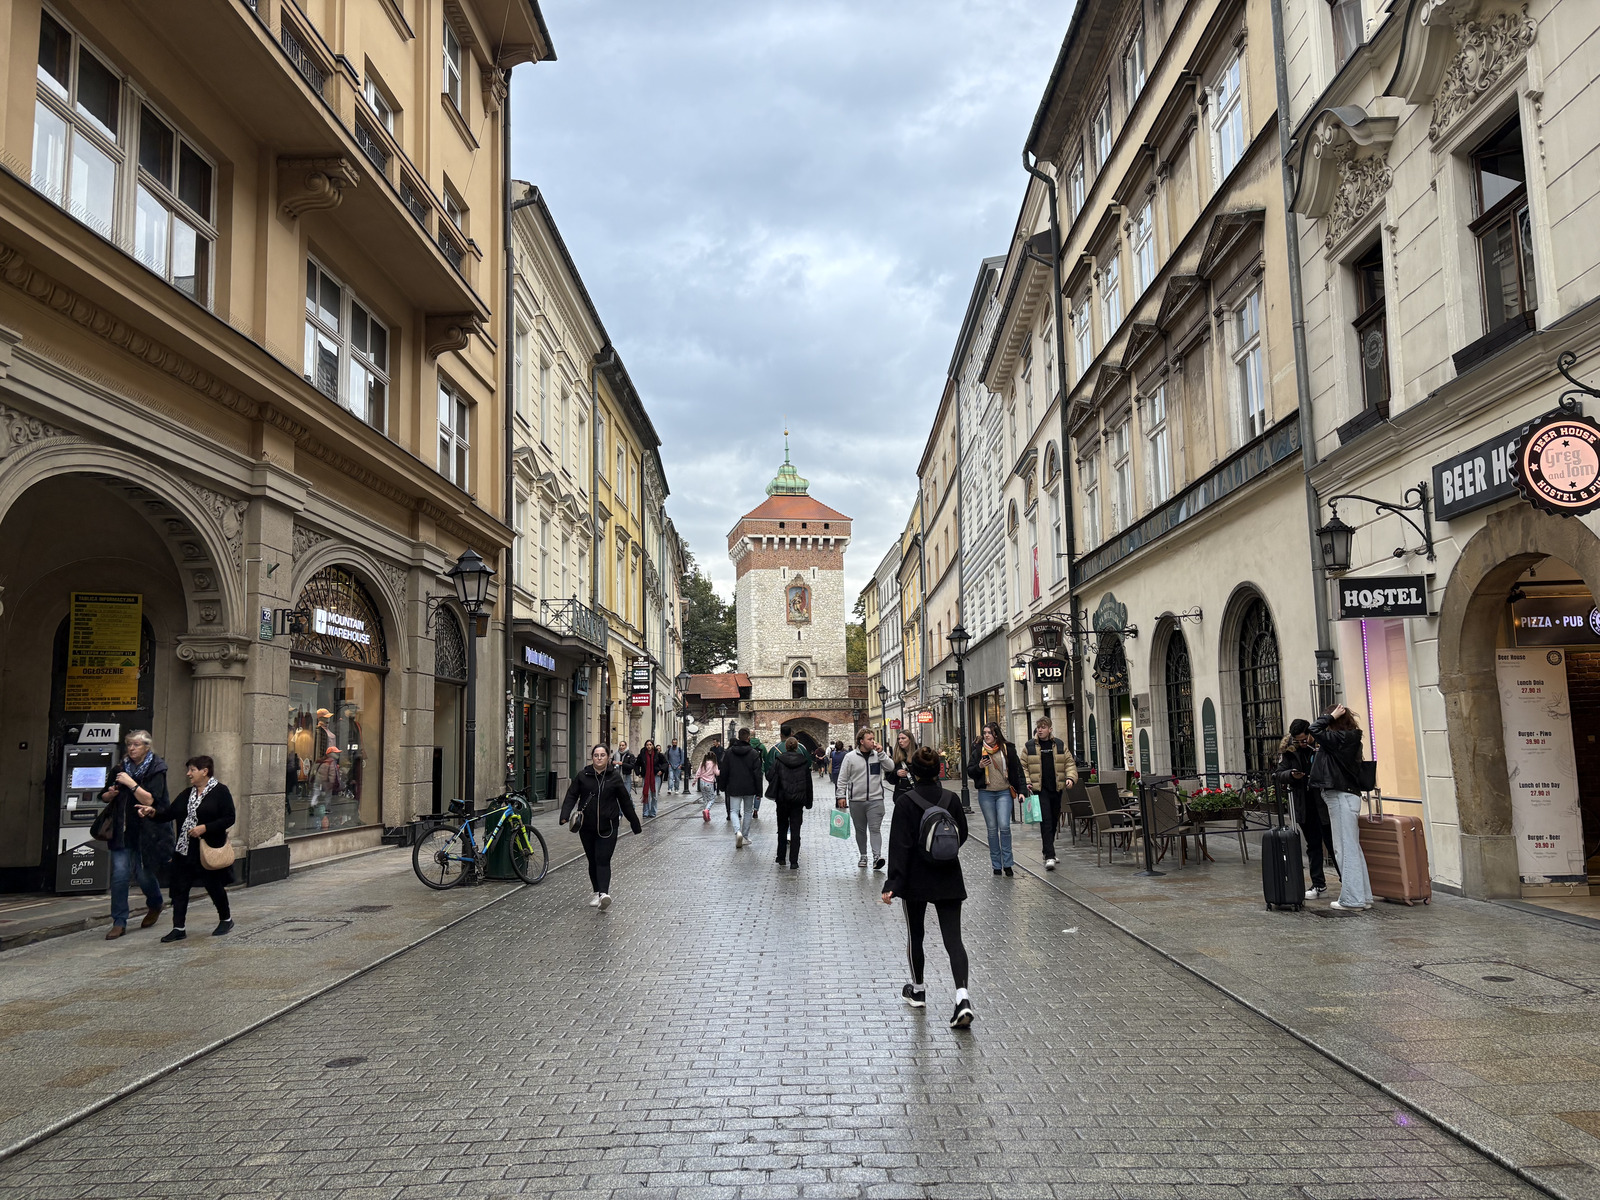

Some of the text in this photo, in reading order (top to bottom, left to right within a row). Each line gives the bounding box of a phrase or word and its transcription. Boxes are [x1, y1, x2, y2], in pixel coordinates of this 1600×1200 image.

[1533, 427, 1597, 453] BEER HOUSE
[1544, 448, 1582, 468] Greg
[1442, 456, 1488, 506] BEER
[1548, 462, 1596, 480] and Tom
[1537, 479, 1577, 502] HOSTEL
[1580, 490, 1589, 499] &
[1344, 587, 1422, 607] HOSTEL
[328, 612, 365, 631] MOUNTAIN
[1520, 616, 1584, 628] PIZZA PUB
[327, 625, 371, 645] WAREHOUSE
[1037, 667, 1062, 677] PUB
[86, 728, 111, 737] ATM
